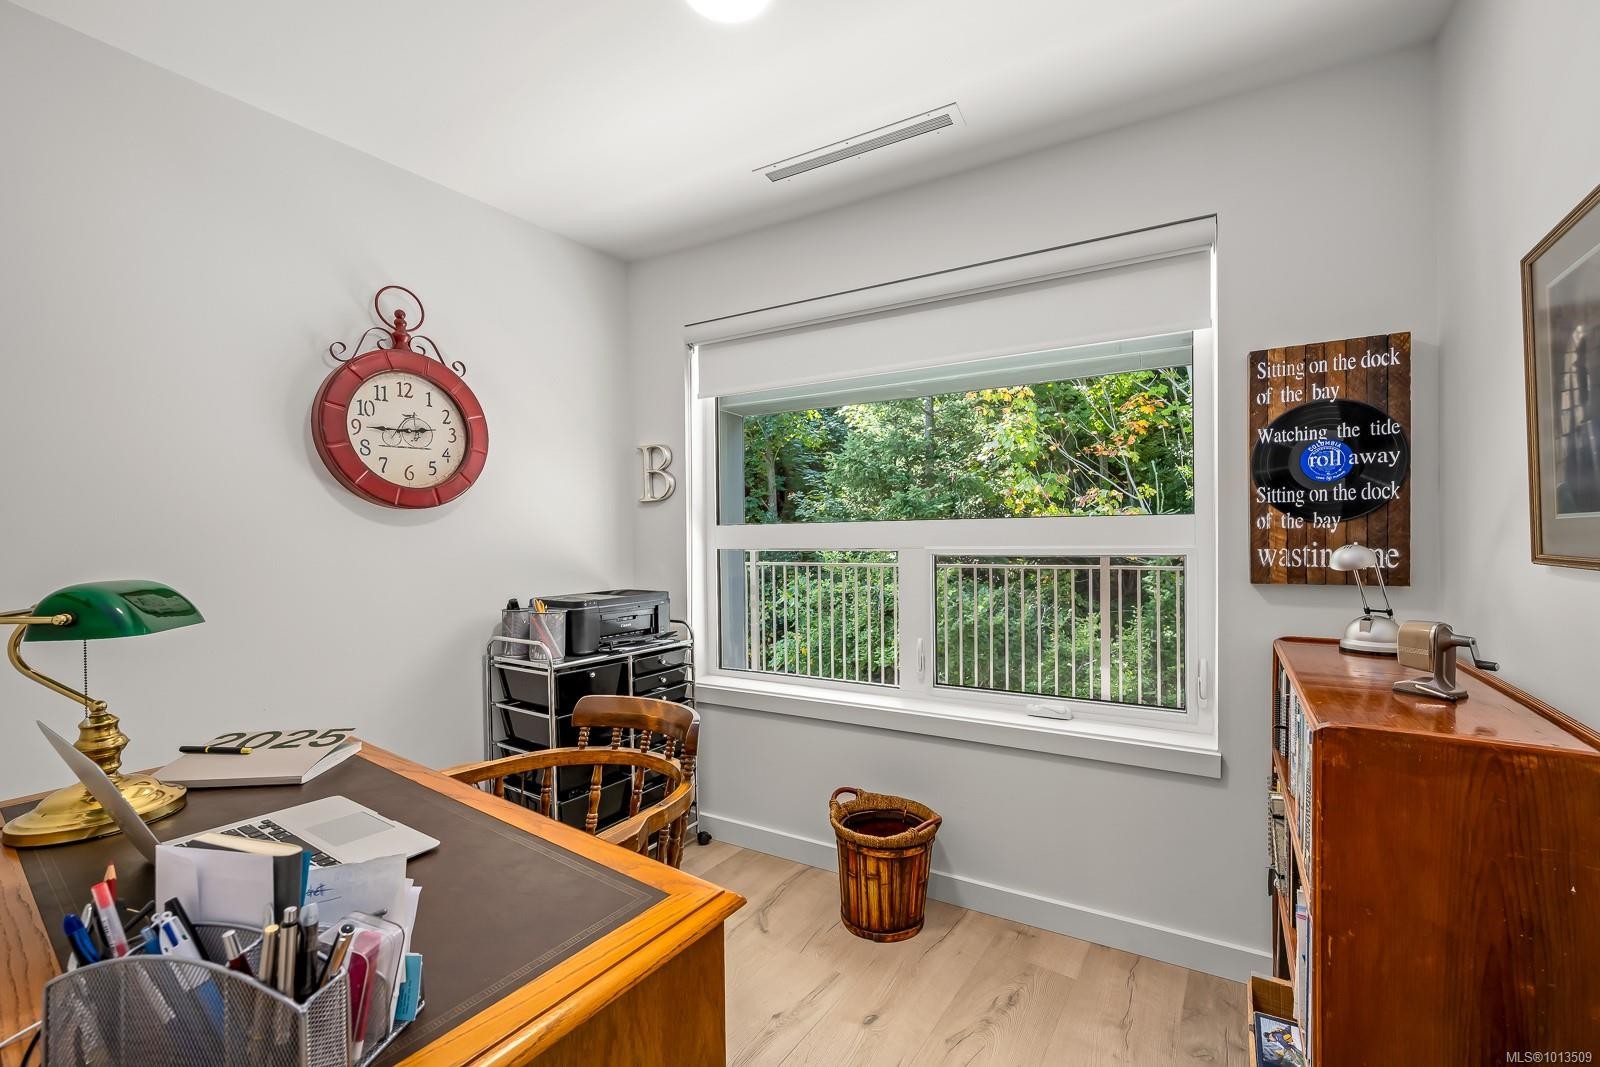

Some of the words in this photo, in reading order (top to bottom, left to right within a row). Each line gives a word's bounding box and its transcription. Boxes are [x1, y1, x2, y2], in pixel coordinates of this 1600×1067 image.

[1257, 361, 1305, 380] Sitting
[1309, 359, 1328, 374] on
[1333, 353, 1356, 371] the
[1360, 347, 1400, 368] dock
[373, 385, 389, 402] 11
[396, 382, 414, 399] 12
[1256, 387, 1273, 405] of
[1280, 386, 1303, 403] the
[1312, 383, 1340, 403] bay
[356, 399, 375, 416] 10
[425, 392, 433, 407] 1
[441, 409, 451, 425] 2
[351, 418, 362, 435] 9
[448, 427, 457, 443] 3
[1257, 426, 1328, 444] Watching
[1336, 422, 1360, 438] the
[1370, 418, 1400, 436] tide
[359, 438, 371, 456] 8
[1307, 440, 1342, 452] COLUMBIA
[441, 447, 451, 463] 4
[1309, 450, 1342, 467] roll
[1348, 450, 1400, 467] away
[378, 456, 388, 473] 7
[404, 464, 415, 481] 6
[428, 460, 437, 476] 5
[636, 444, 677, 502] B
[1256, 486, 1305, 507] Sitting
[1309, 488, 1328, 502] on
[1333, 483, 1356, 501] the
[1361, 481, 1400, 500] dock
[1256, 512, 1273, 529] of
[1281, 512, 1304, 529] the
[1313, 511, 1341, 533] bay
[211, 727, 356, 750] 2025
